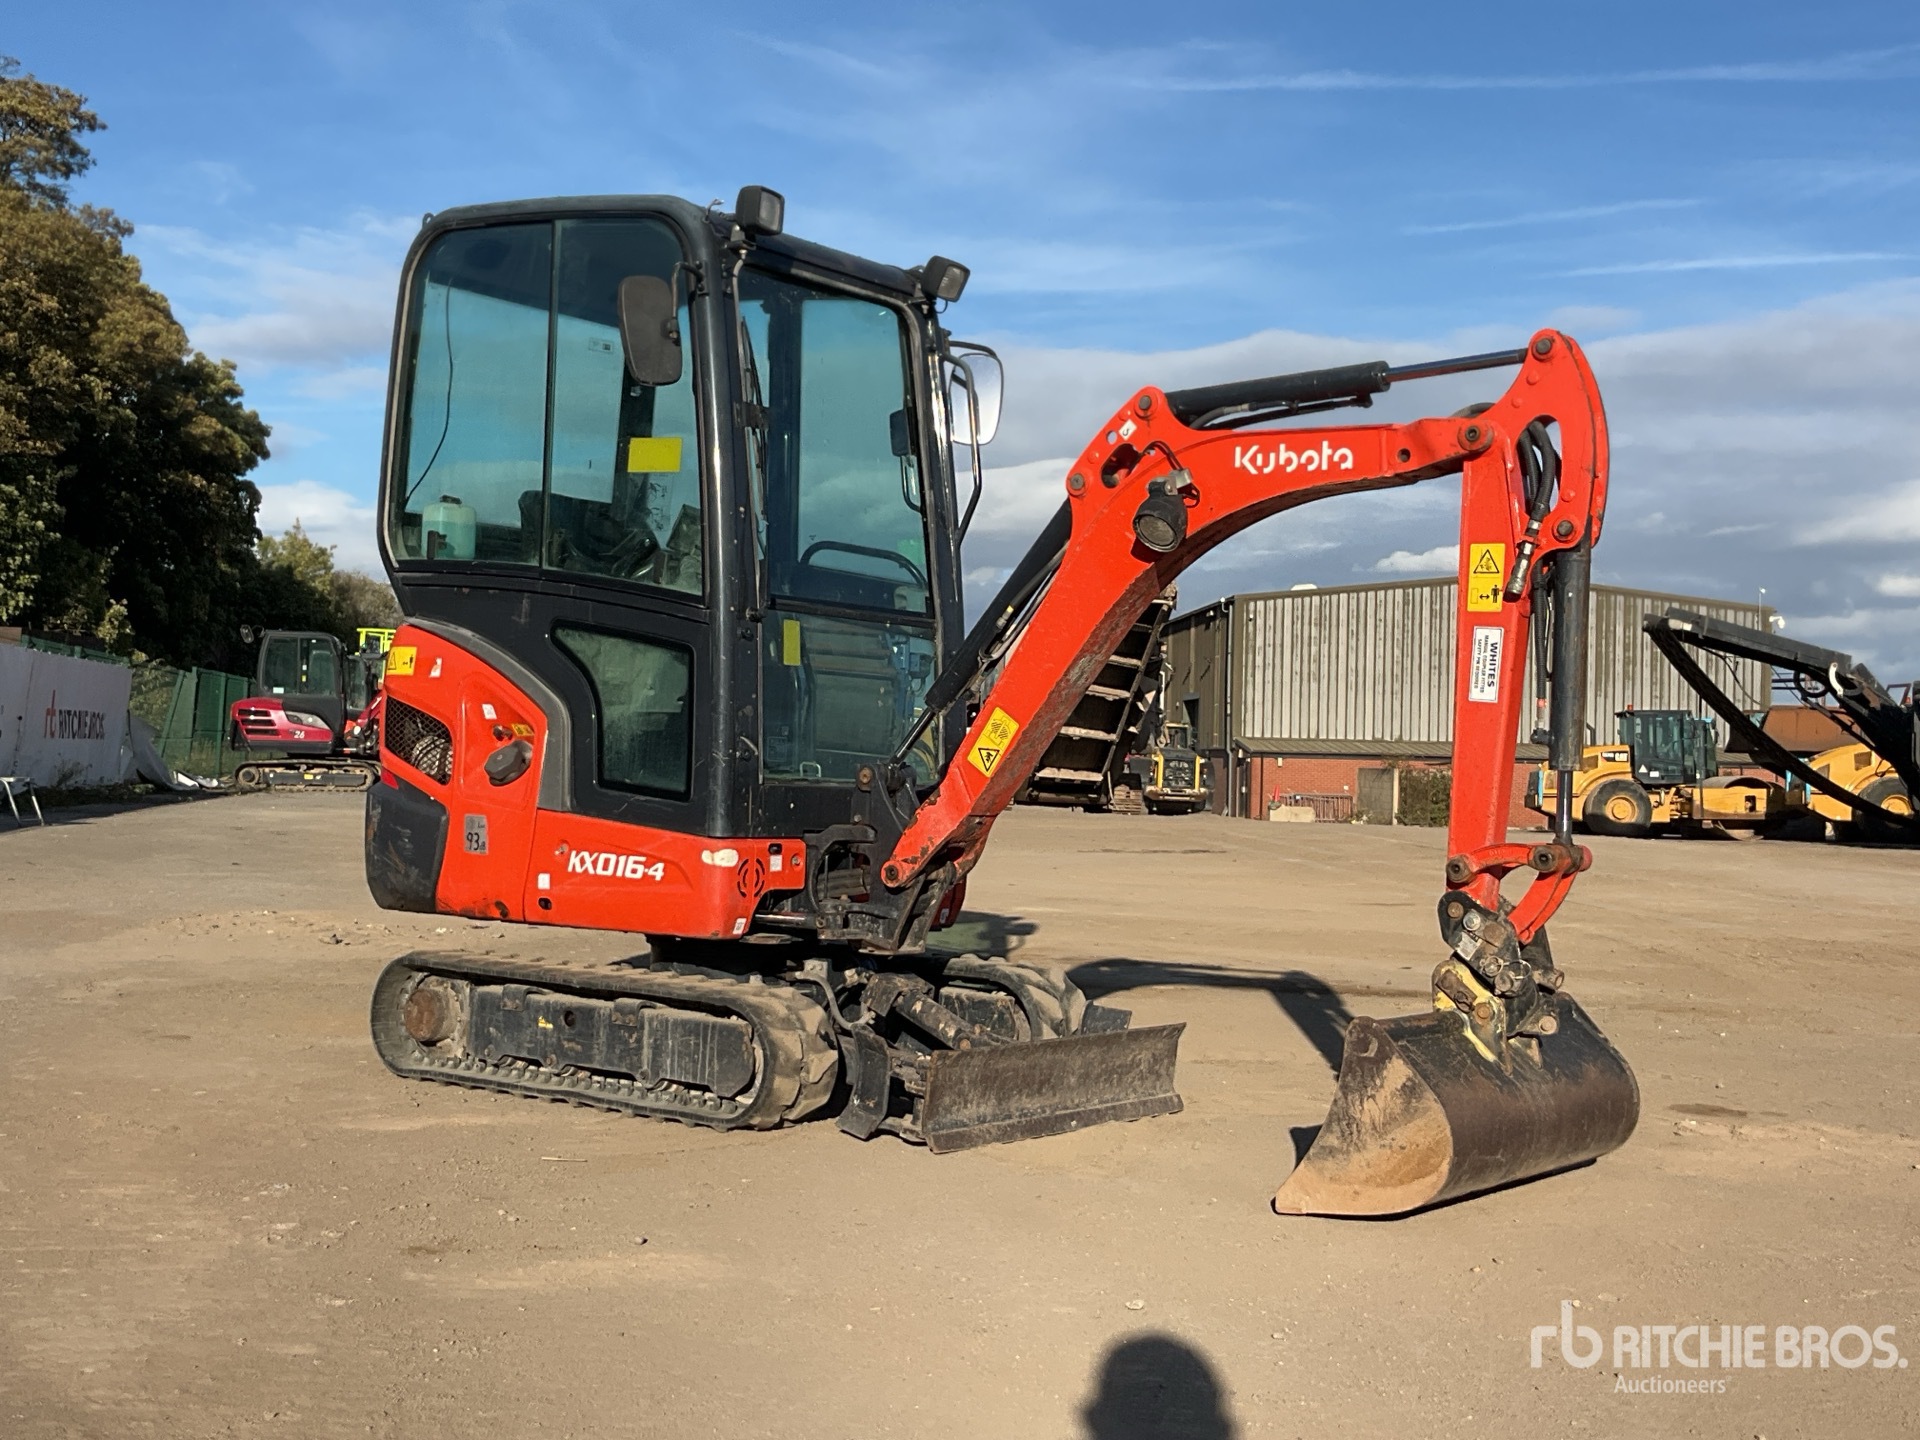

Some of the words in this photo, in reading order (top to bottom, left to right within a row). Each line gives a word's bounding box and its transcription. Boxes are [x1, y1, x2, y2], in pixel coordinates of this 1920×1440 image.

[1234, 440, 1354, 475] Kubota
[1487, 642, 1499, 688] WHITES
[466, 831, 480, 851] 93
[567, 850, 665, 881] KX016-4
